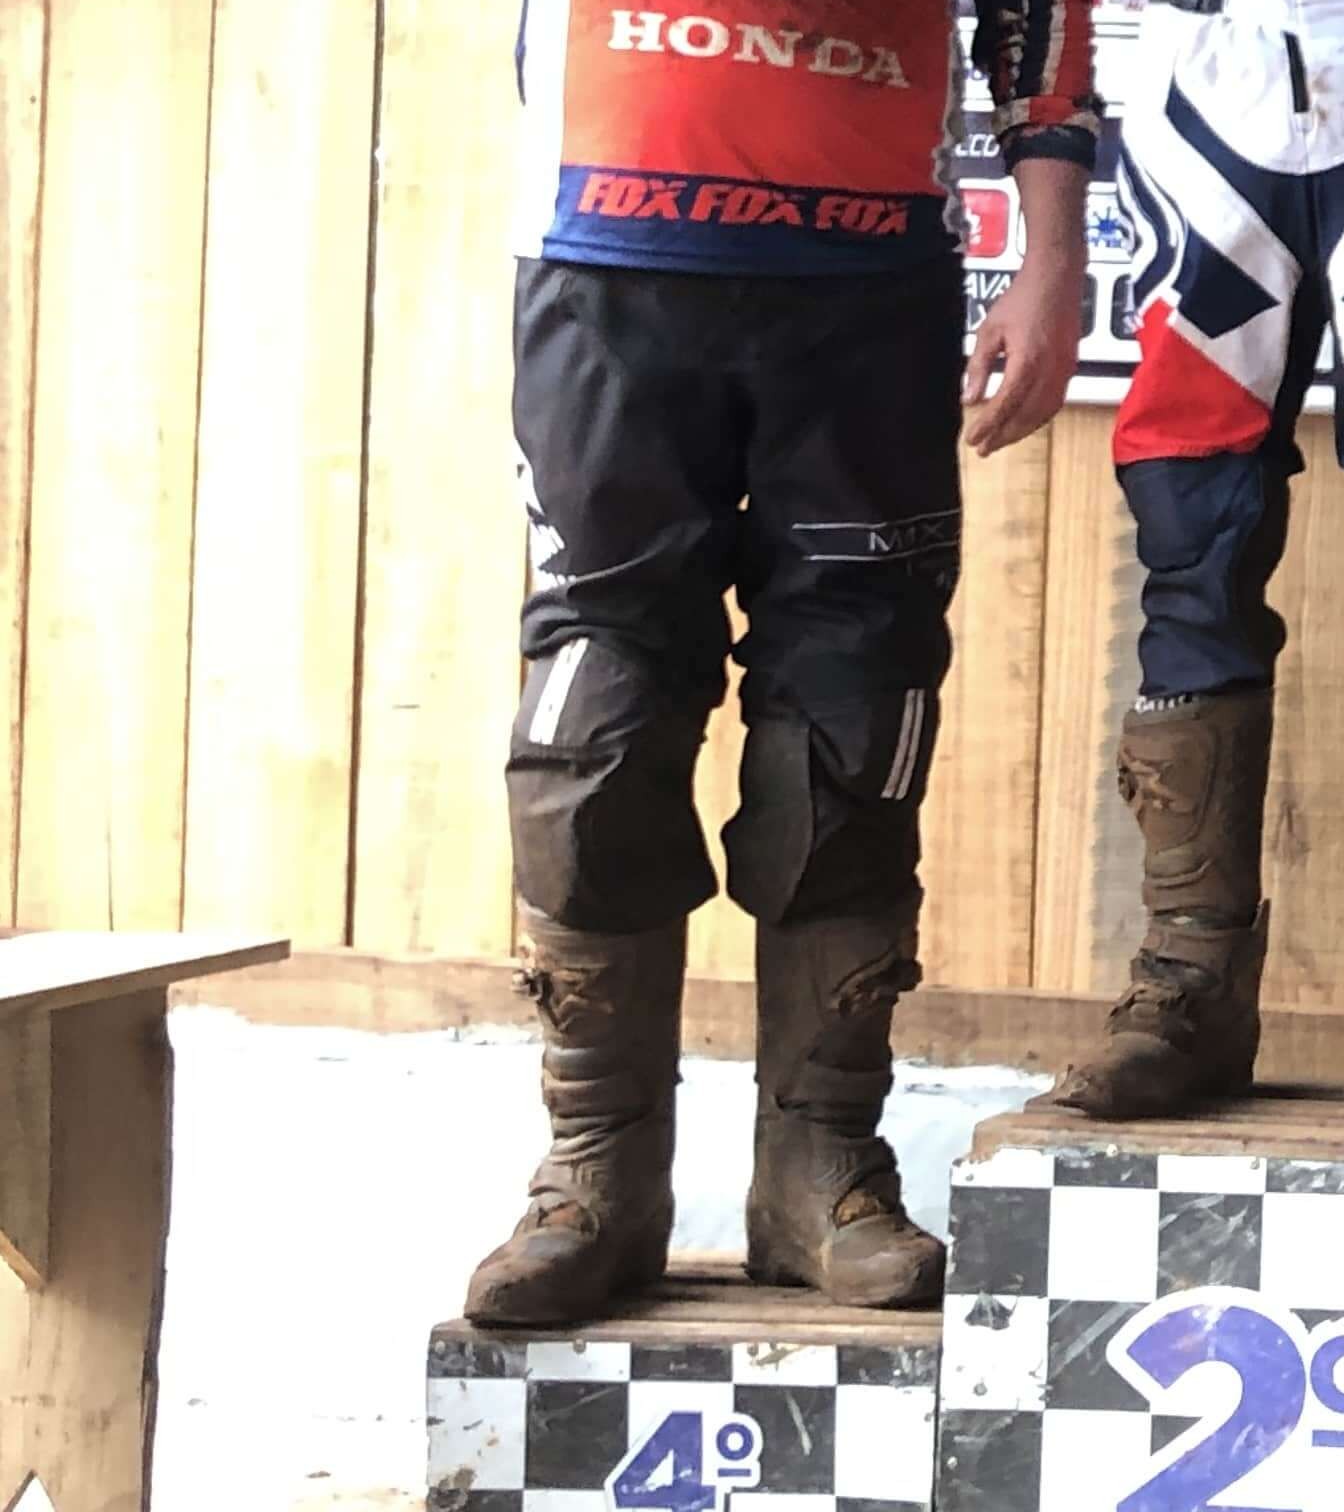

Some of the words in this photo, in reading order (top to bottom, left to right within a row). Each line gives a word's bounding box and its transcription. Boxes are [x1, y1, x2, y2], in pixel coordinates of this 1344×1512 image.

[607, 9, 911, 90] HONDA
[577, 172, 688, 221] FOX
[689, 183, 806, 226] FOX
[815, 195, 910, 235] FOX
